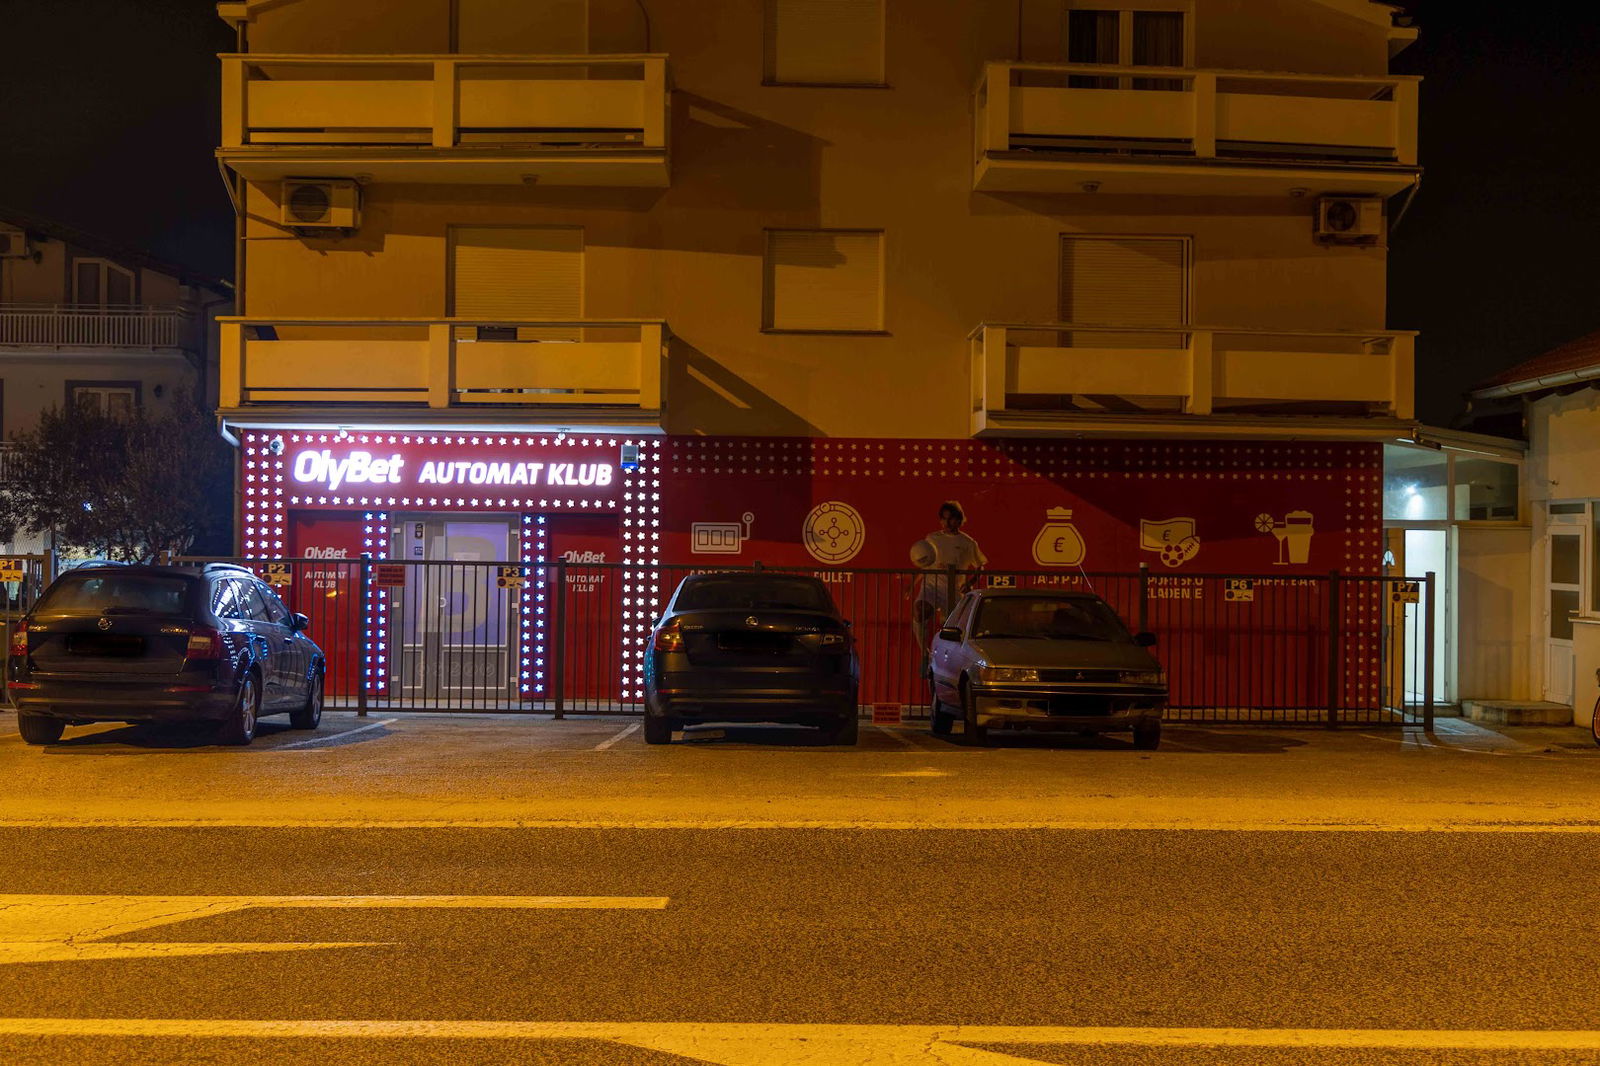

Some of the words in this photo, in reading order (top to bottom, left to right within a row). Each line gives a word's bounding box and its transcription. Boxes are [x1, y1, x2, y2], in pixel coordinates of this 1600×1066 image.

[294, 450, 404, 490] OlyBet
[419, 461, 544, 485] AUTOMAT
[548, 463, 612, 486] KLUB
[305, 547, 347, 560] OlyBet
[564, 551, 606, 564] OlyBet
[0, 560, 15, 570] P1
[268, 564, 286, 573] P2
[503, 568, 520, 577] P3
[993, 576, 1010, 586] P5
[1231, 580, 1248, 590] P6
[1398, 583, 1414, 591] P7
